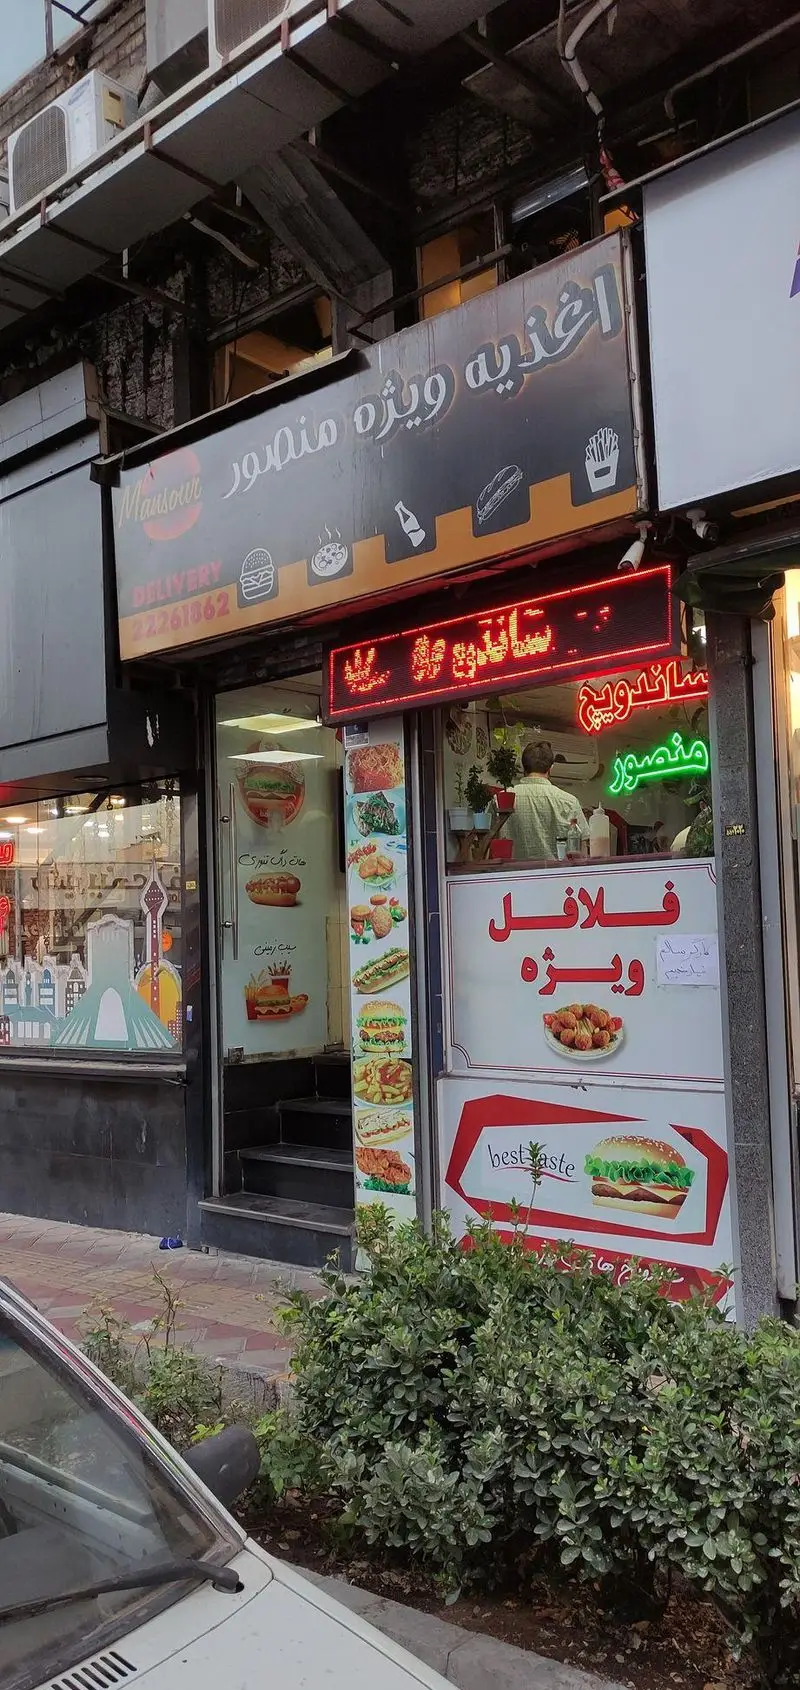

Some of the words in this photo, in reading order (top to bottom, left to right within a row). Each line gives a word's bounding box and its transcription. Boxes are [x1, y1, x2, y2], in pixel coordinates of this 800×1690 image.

[465, 275, 612, 394] اغذیه
[353, 373, 447, 440] ویژه
[222, 415, 338, 499] منصور
[118, 477, 203, 529] Mansour
[131, 560, 223, 608] DELIVERY
[132, 591, 230, 642] 22261862
[579, 660, 708, 732] ساندویچ
[609, 732, 709, 793] منصور
[488, 880, 681, 943] فلافل
[278, 943, 297, 955] سیب
[520, 946, 645, 996] ویژه
[488, 1144, 526, 1168] best
[531, 1147, 576, 1178] aste
